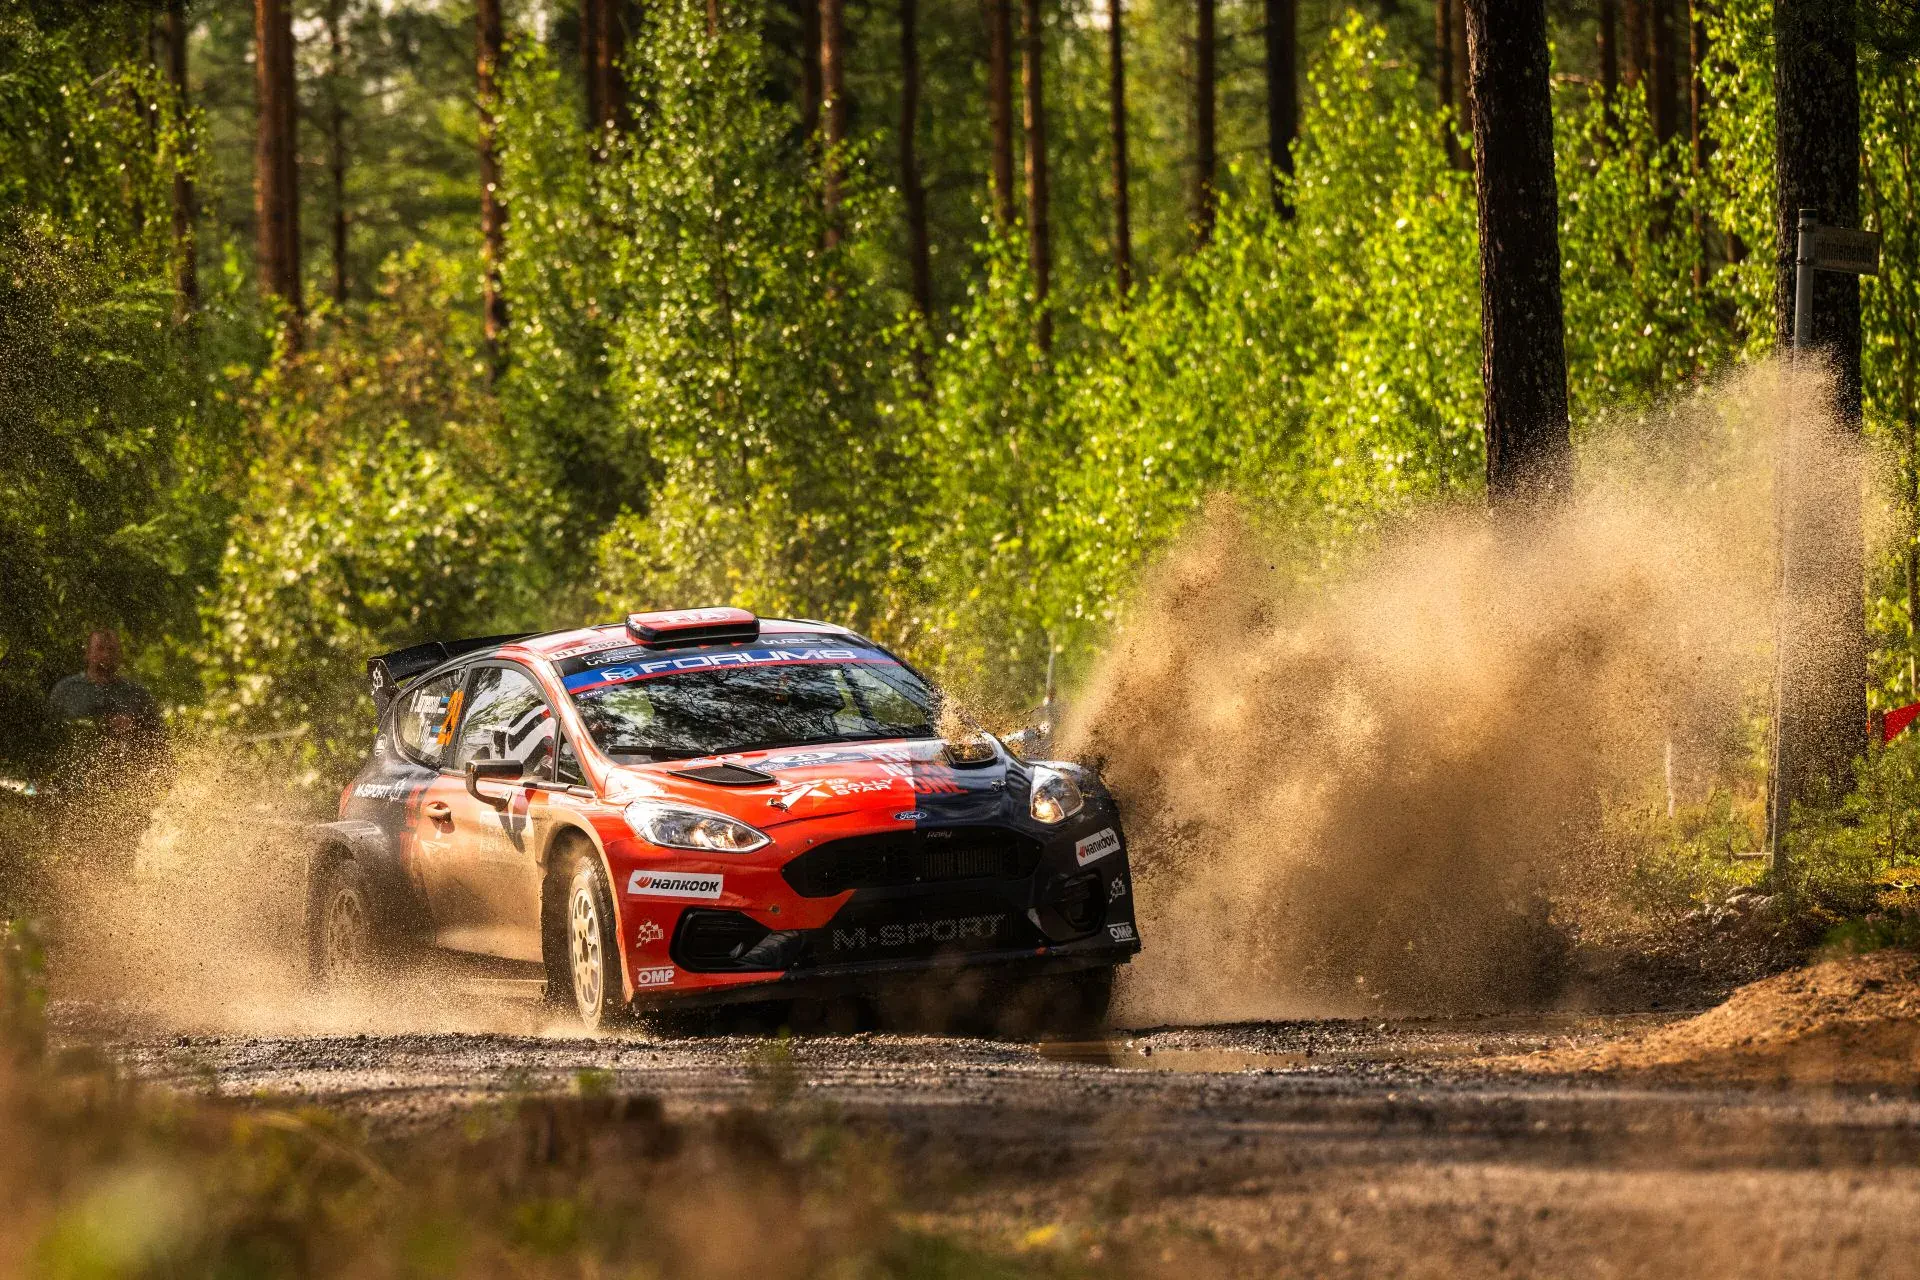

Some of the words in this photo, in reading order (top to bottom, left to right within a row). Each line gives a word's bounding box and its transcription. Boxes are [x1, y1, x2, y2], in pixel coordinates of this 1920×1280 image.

[640, 650, 857, 674] FORUM8
[784, 753, 821, 762] 29
[830, 779, 892, 791] RALLY
[836, 785, 891, 796] STAR
[905, 777, 968, 794] ONE
[899, 811, 922, 820] Ford
[1109, 925, 1133, 940] OMP
[638, 969, 675, 983] OMP
